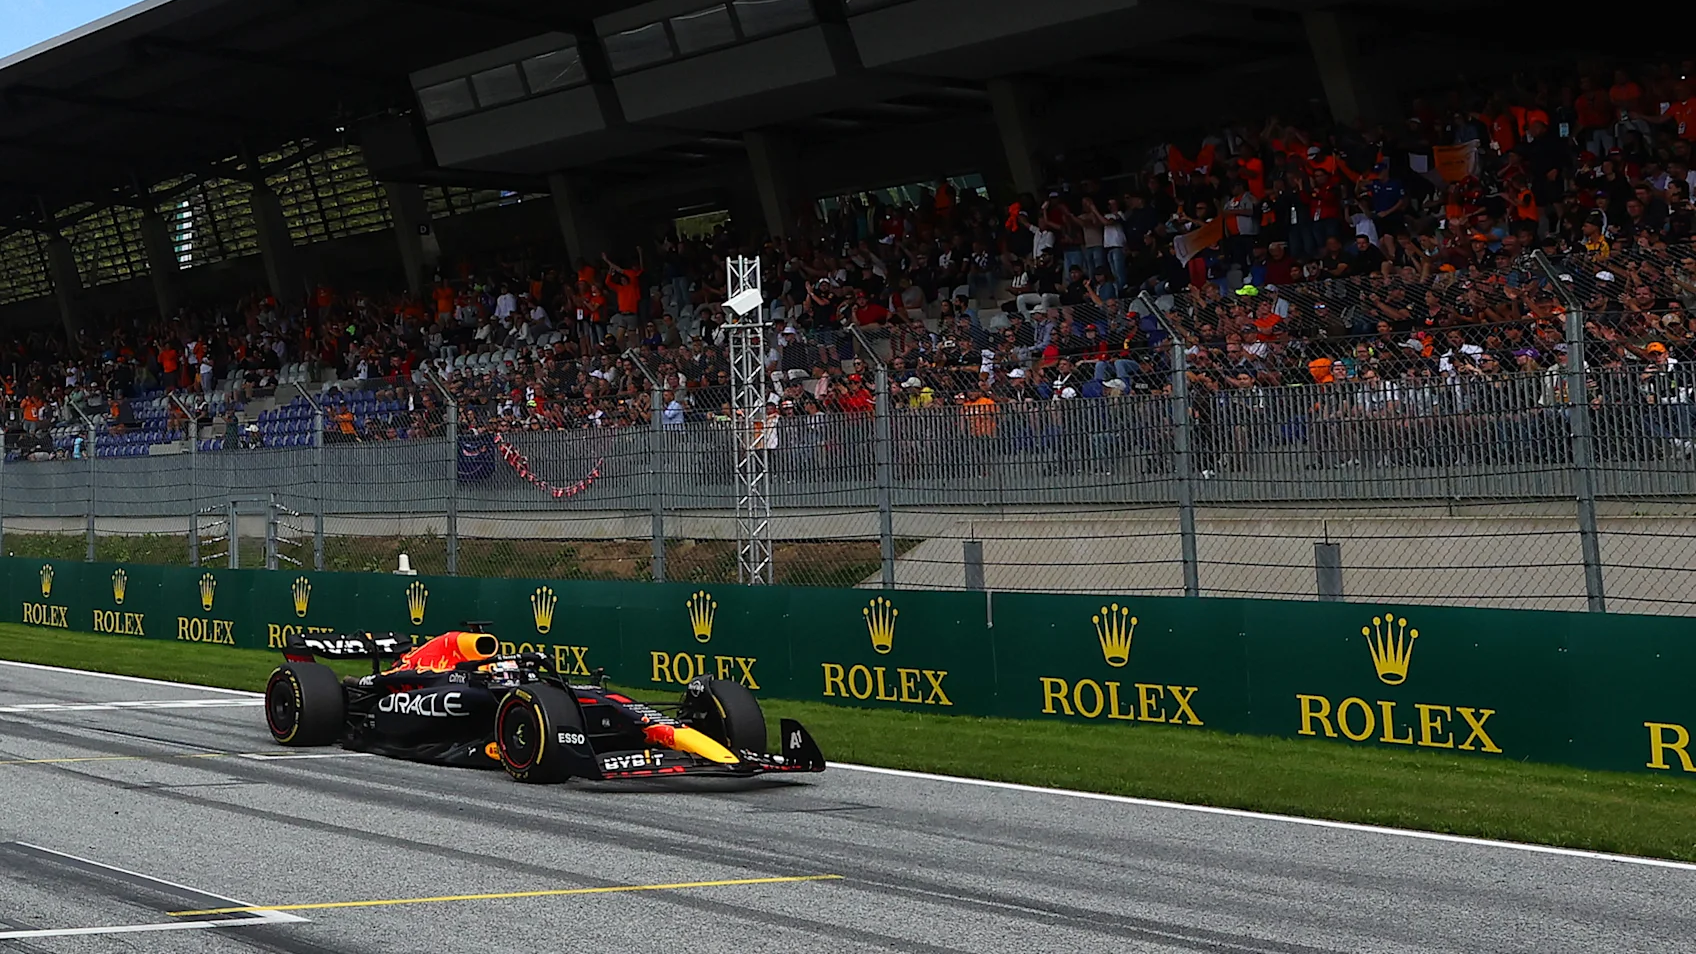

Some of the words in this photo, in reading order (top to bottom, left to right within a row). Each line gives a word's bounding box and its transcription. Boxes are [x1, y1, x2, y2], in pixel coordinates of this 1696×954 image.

[22, 602, 68, 628] ROLEX
[93, 609, 144, 637] ROLEX
[177, 616, 235, 645] ROLEX
[822, 663, 953, 706] ROLEX
[378, 692, 470, 717] ORACLE
[1040, 677, 1204, 726] ROLEX
[1296, 694, 1503, 754] ROLEX
[557, 732, 585, 745] ESSO
